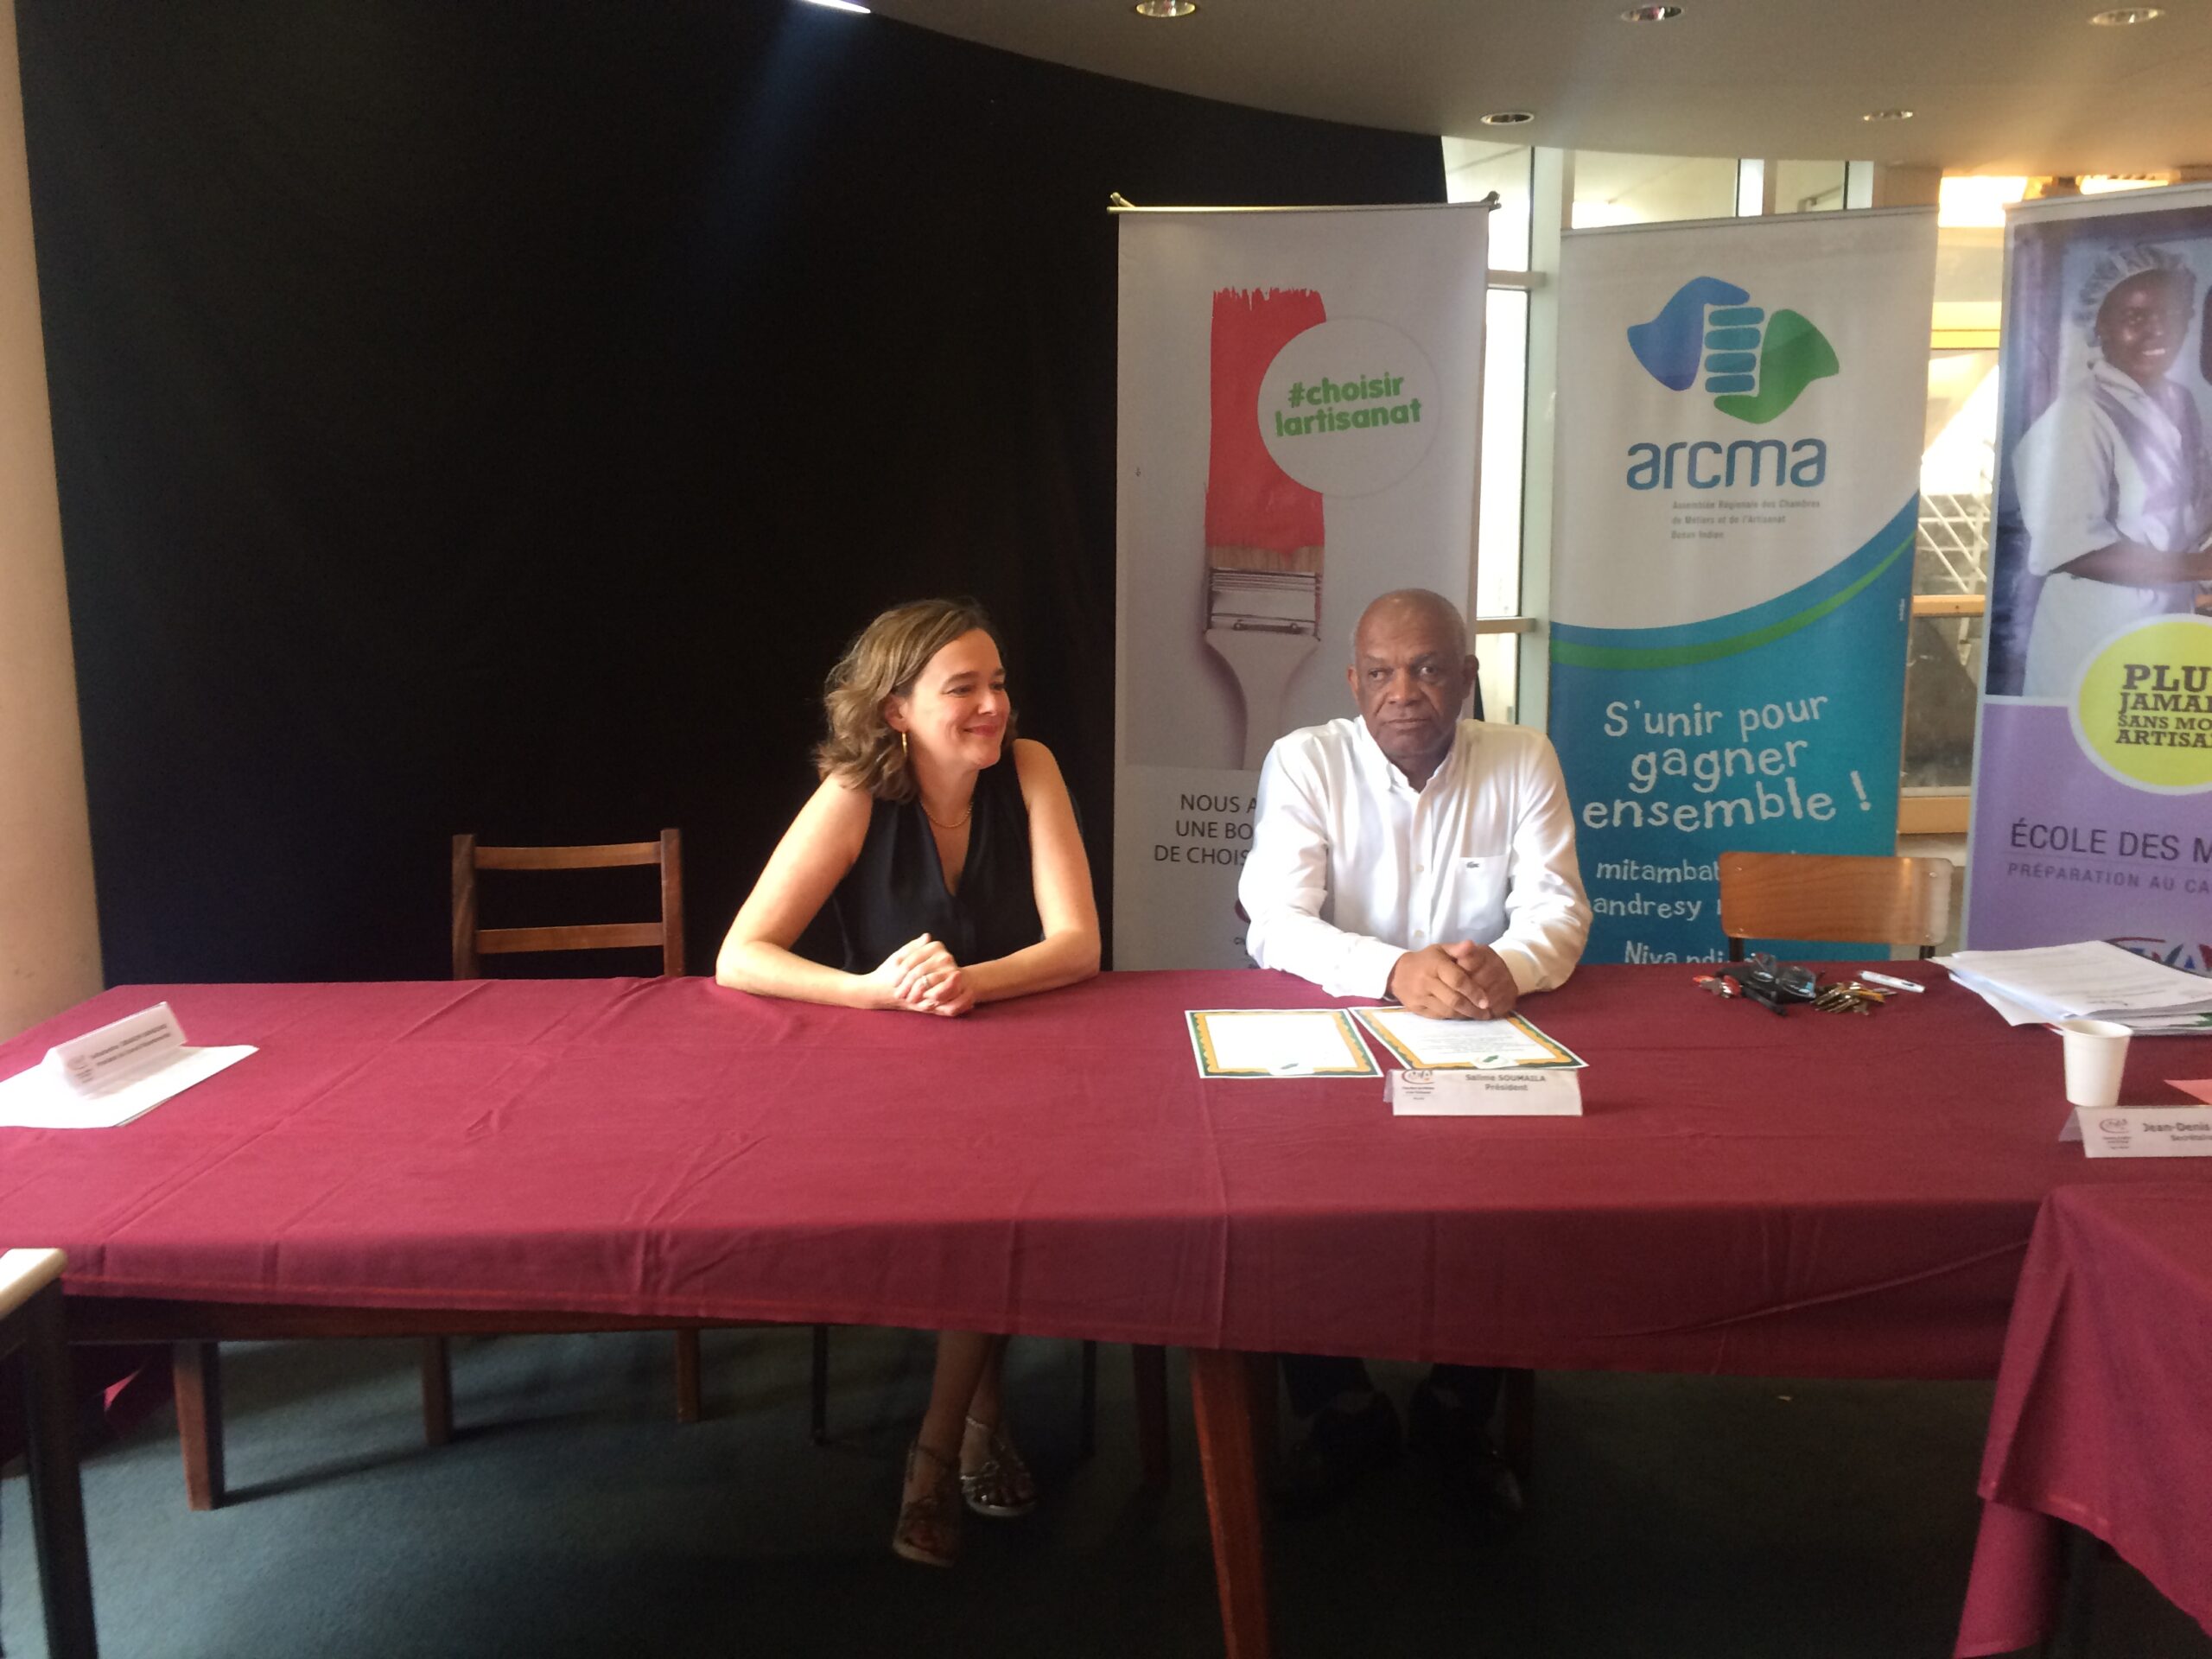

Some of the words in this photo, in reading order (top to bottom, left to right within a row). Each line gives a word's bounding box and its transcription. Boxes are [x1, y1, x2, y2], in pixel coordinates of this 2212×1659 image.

[1288, 372, 1404, 408] #choisir
[1274, 397, 1421, 436] lartisanat
[1626, 438, 1827, 490] arcma
[1604, 700, 1723, 738] S'unir
[1739, 696, 1829, 742] pour
[2118, 714, 2169, 729] SANS
[2115, 728, 2212, 749] ARTISA
[1628, 739, 1808, 794] gagner
[1180, 793, 1241, 813] NOUS
[1582, 777, 1836, 832] ensemble
[1851, 771, 1872, 811] !
[1176, 820, 1218, 839] UNE
[2011, 817, 2107, 855] ÉCOLE
[2119, 831, 2179, 861] DES
[1154, 844, 1181, 862] DE
[2006, 863, 2140, 888] PRÉPARATION
[2149, 875, 2175, 892] AU
[1592, 893, 1702, 921] andresy
